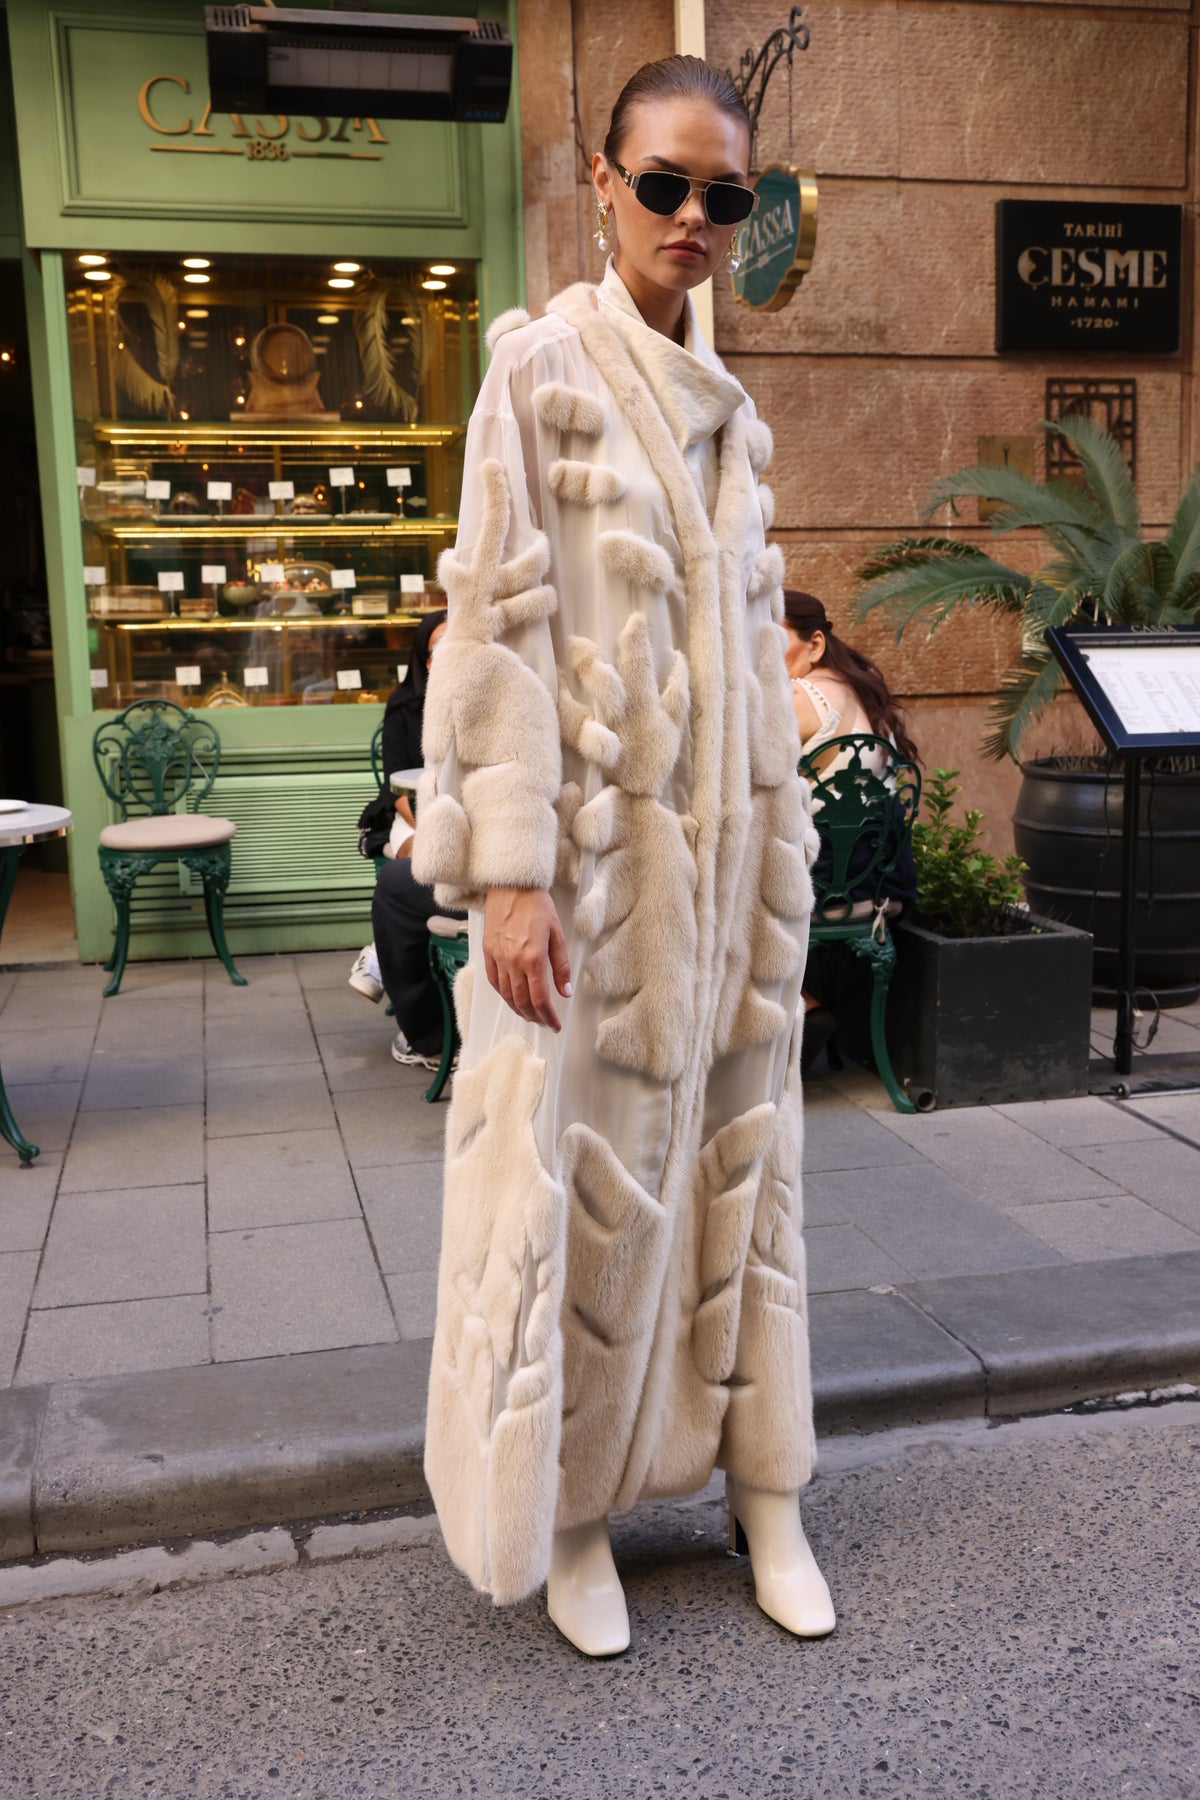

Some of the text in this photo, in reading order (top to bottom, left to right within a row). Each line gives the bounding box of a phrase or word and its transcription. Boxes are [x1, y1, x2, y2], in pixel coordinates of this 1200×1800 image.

[246, 141, 289, 161] 1836
[738, 199, 795, 262] CASSA
[1063, 222, 1123, 238] TARİHİ
[1017, 246, 1168, 291] ÇEŞME
[1051, 295, 1139, 309] HAMAMI
